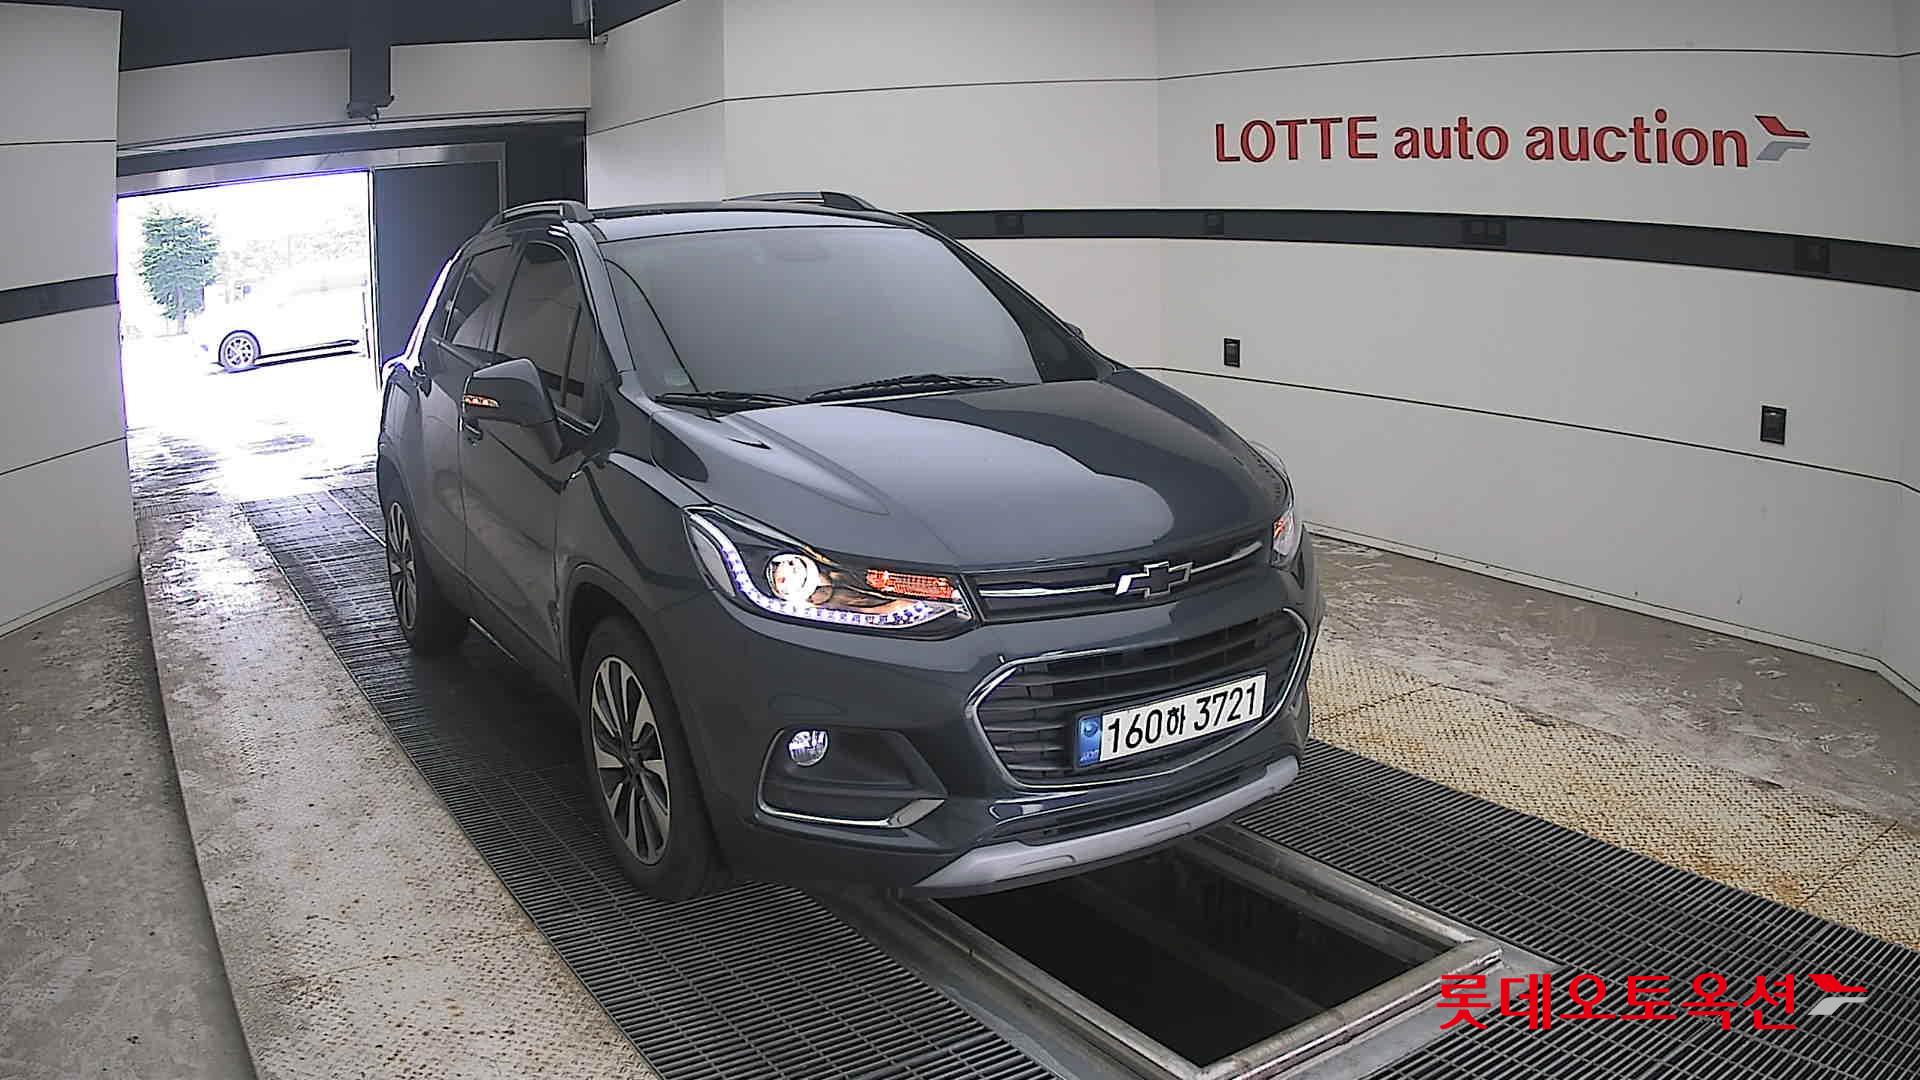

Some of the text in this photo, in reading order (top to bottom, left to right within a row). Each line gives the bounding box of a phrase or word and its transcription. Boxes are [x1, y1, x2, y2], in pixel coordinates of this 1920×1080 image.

[1215, 108, 1749, 168] LOTTE auto auction
[1108, 682, 1257, 753] 160하 3721
